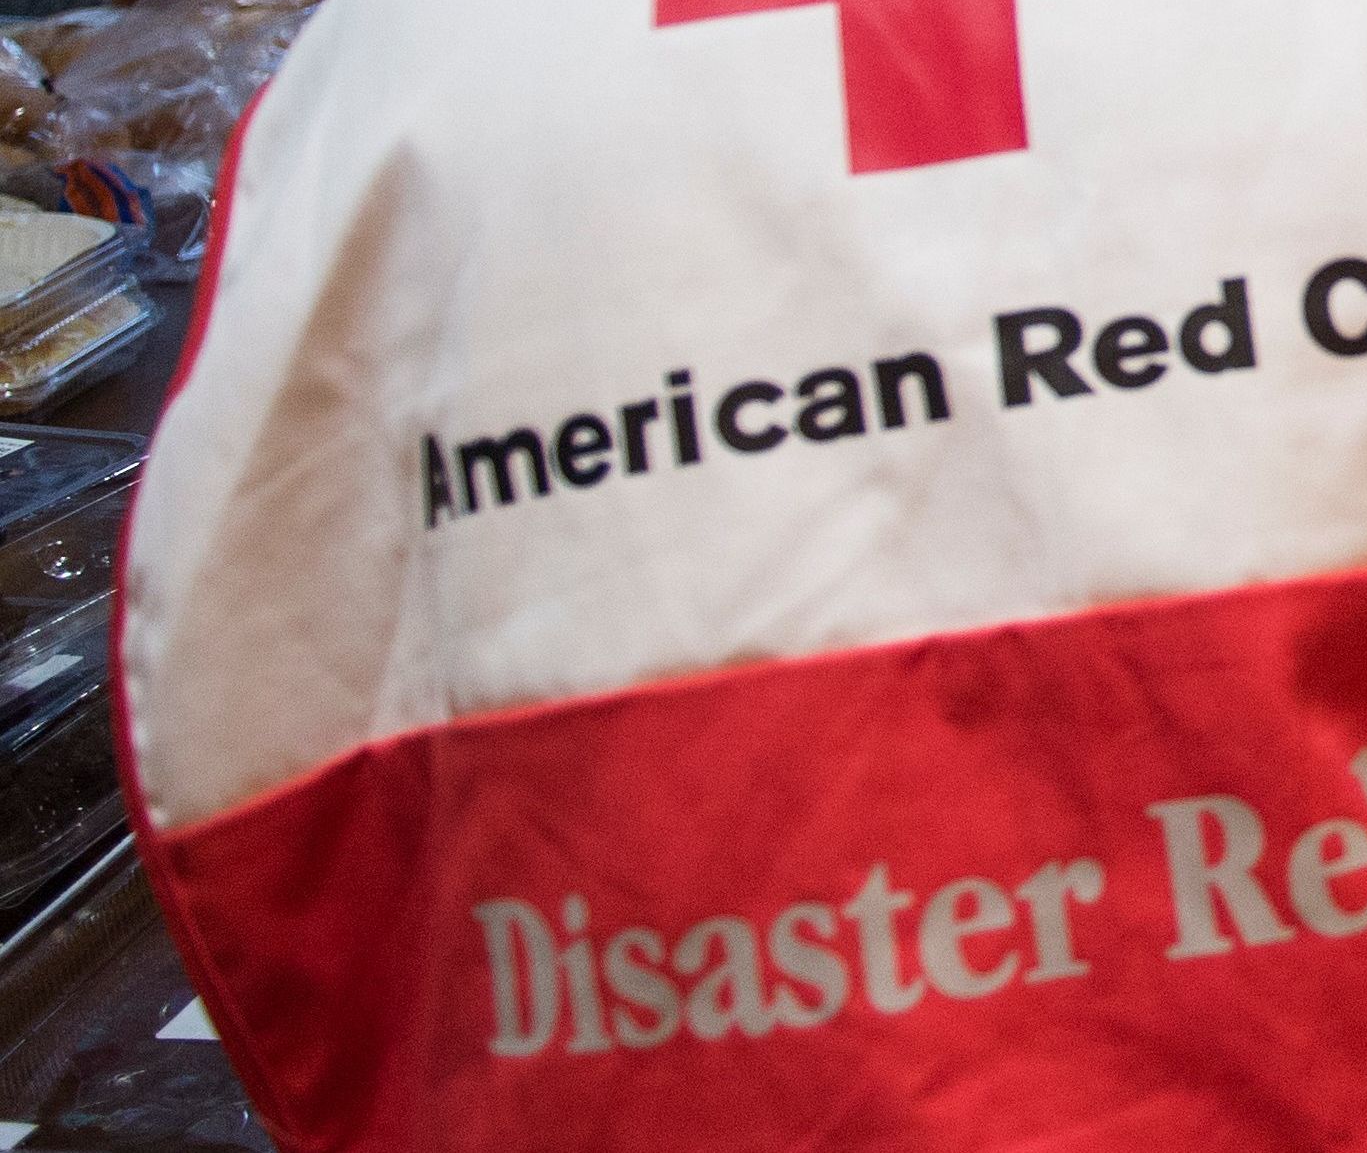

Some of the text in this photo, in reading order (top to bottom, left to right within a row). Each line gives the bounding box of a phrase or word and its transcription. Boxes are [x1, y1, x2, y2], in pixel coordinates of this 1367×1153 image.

[423, 351, 952, 530] American
[993, 276, 1256, 410] Red
[473, 856, 1107, 1060] Disaster
